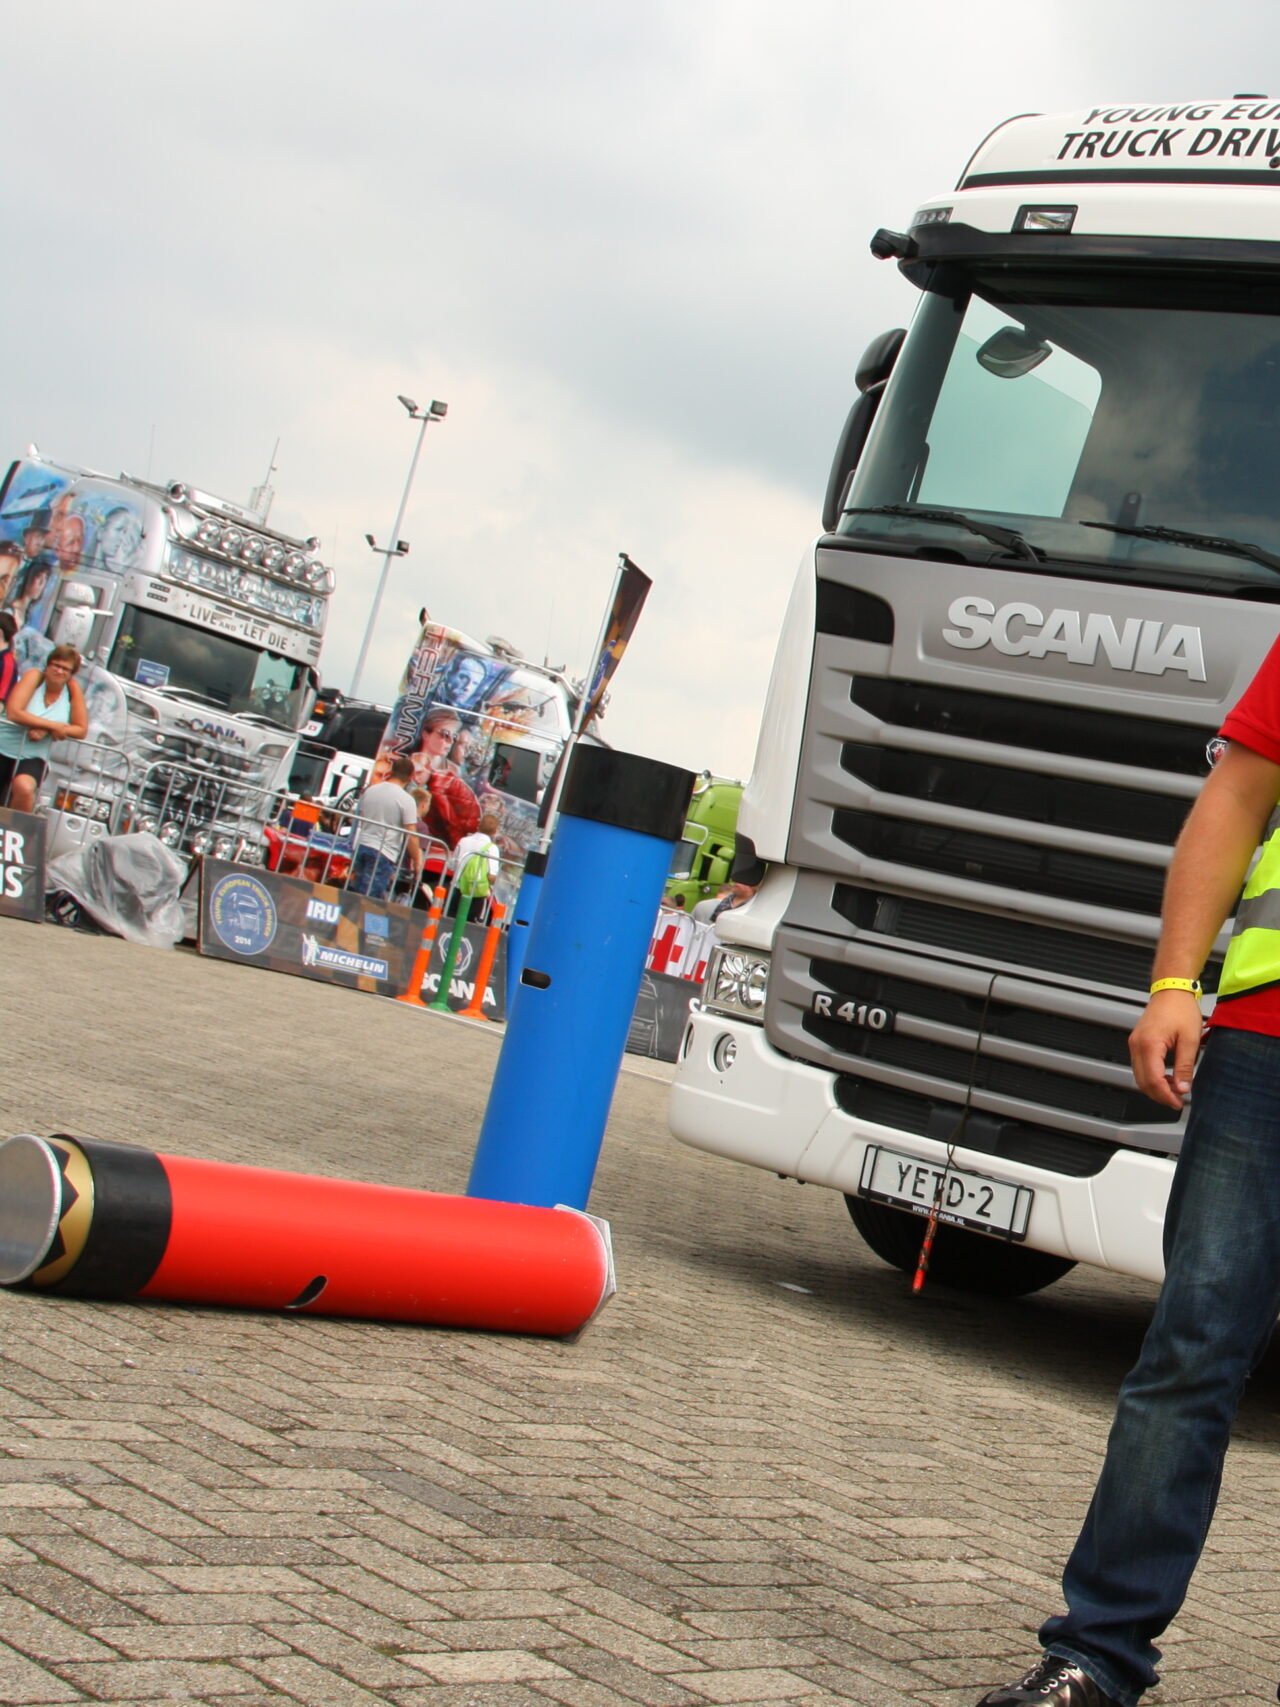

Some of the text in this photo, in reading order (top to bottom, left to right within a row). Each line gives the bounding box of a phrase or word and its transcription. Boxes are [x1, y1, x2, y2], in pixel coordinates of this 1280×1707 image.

[1082, 104, 1221, 125] YOUNG
[1057, 128, 1186, 160] TRUCK
[189, 604, 288, 650] LIVE AND LET DIE
[942, 596, 1207, 683] SCANIA
[0, 828, 24, 864] R
[0, 863, 23, 898] S
[306, 900, 341, 923] IRU
[234, 935, 252, 946] 2014
[319, 950, 384, 974] MICHELIN
[421, 971, 496, 1006] SCANA
[814, 994, 887, 1029] R 410
[898, 1161, 994, 1218] YETD-2
